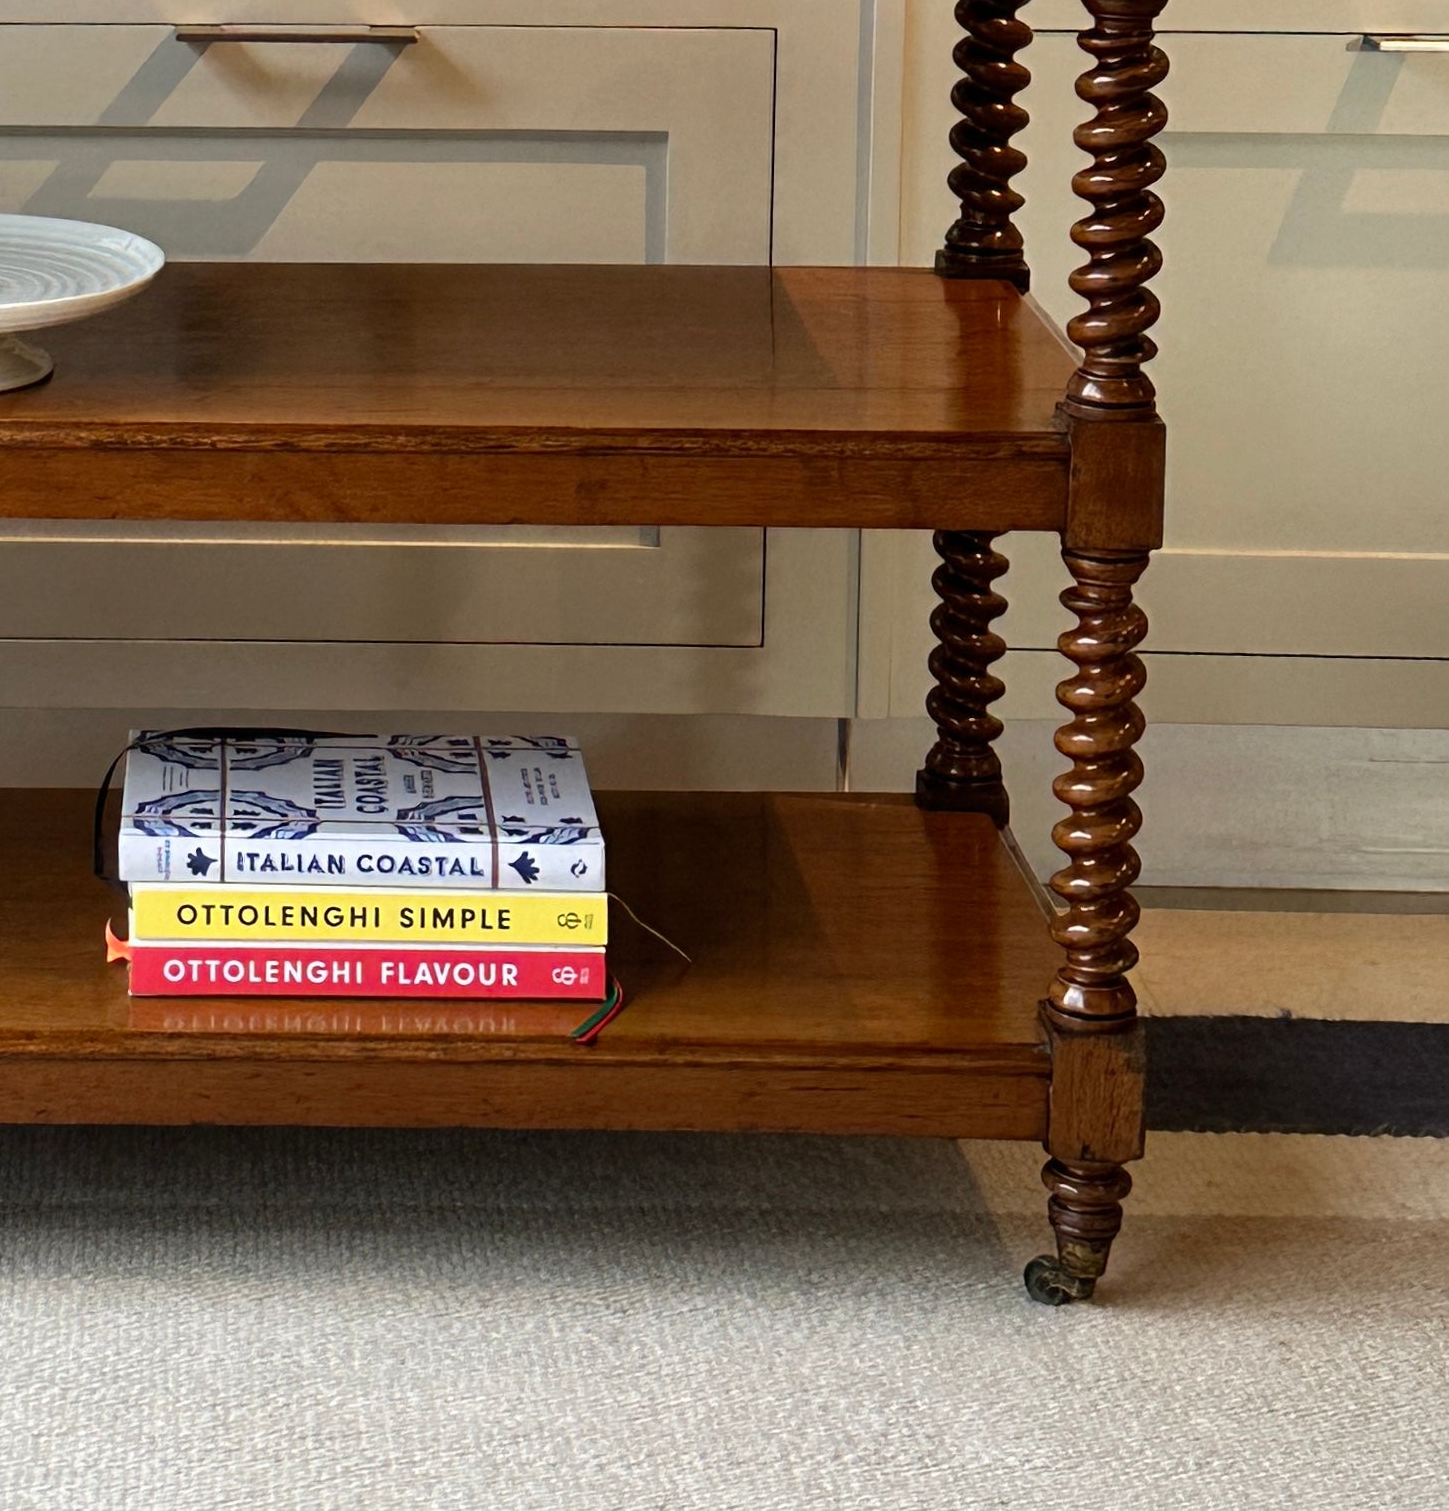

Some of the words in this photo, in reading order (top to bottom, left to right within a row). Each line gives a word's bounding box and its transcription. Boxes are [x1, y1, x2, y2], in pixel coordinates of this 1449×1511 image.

[313, 759, 346, 809] ITALIAN
[353, 755, 388, 814] COASTAL
[237, 852, 345, 874] ITALIAN
[356, 854, 484, 876] COASTAL
[177, 904, 380, 928] OTTOLENGHI
[400, 908, 511, 929] SIMPLE
[163, 959, 362, 984] OTTOLENGHI
[381, 962, 518, 986] FLAVOUR
